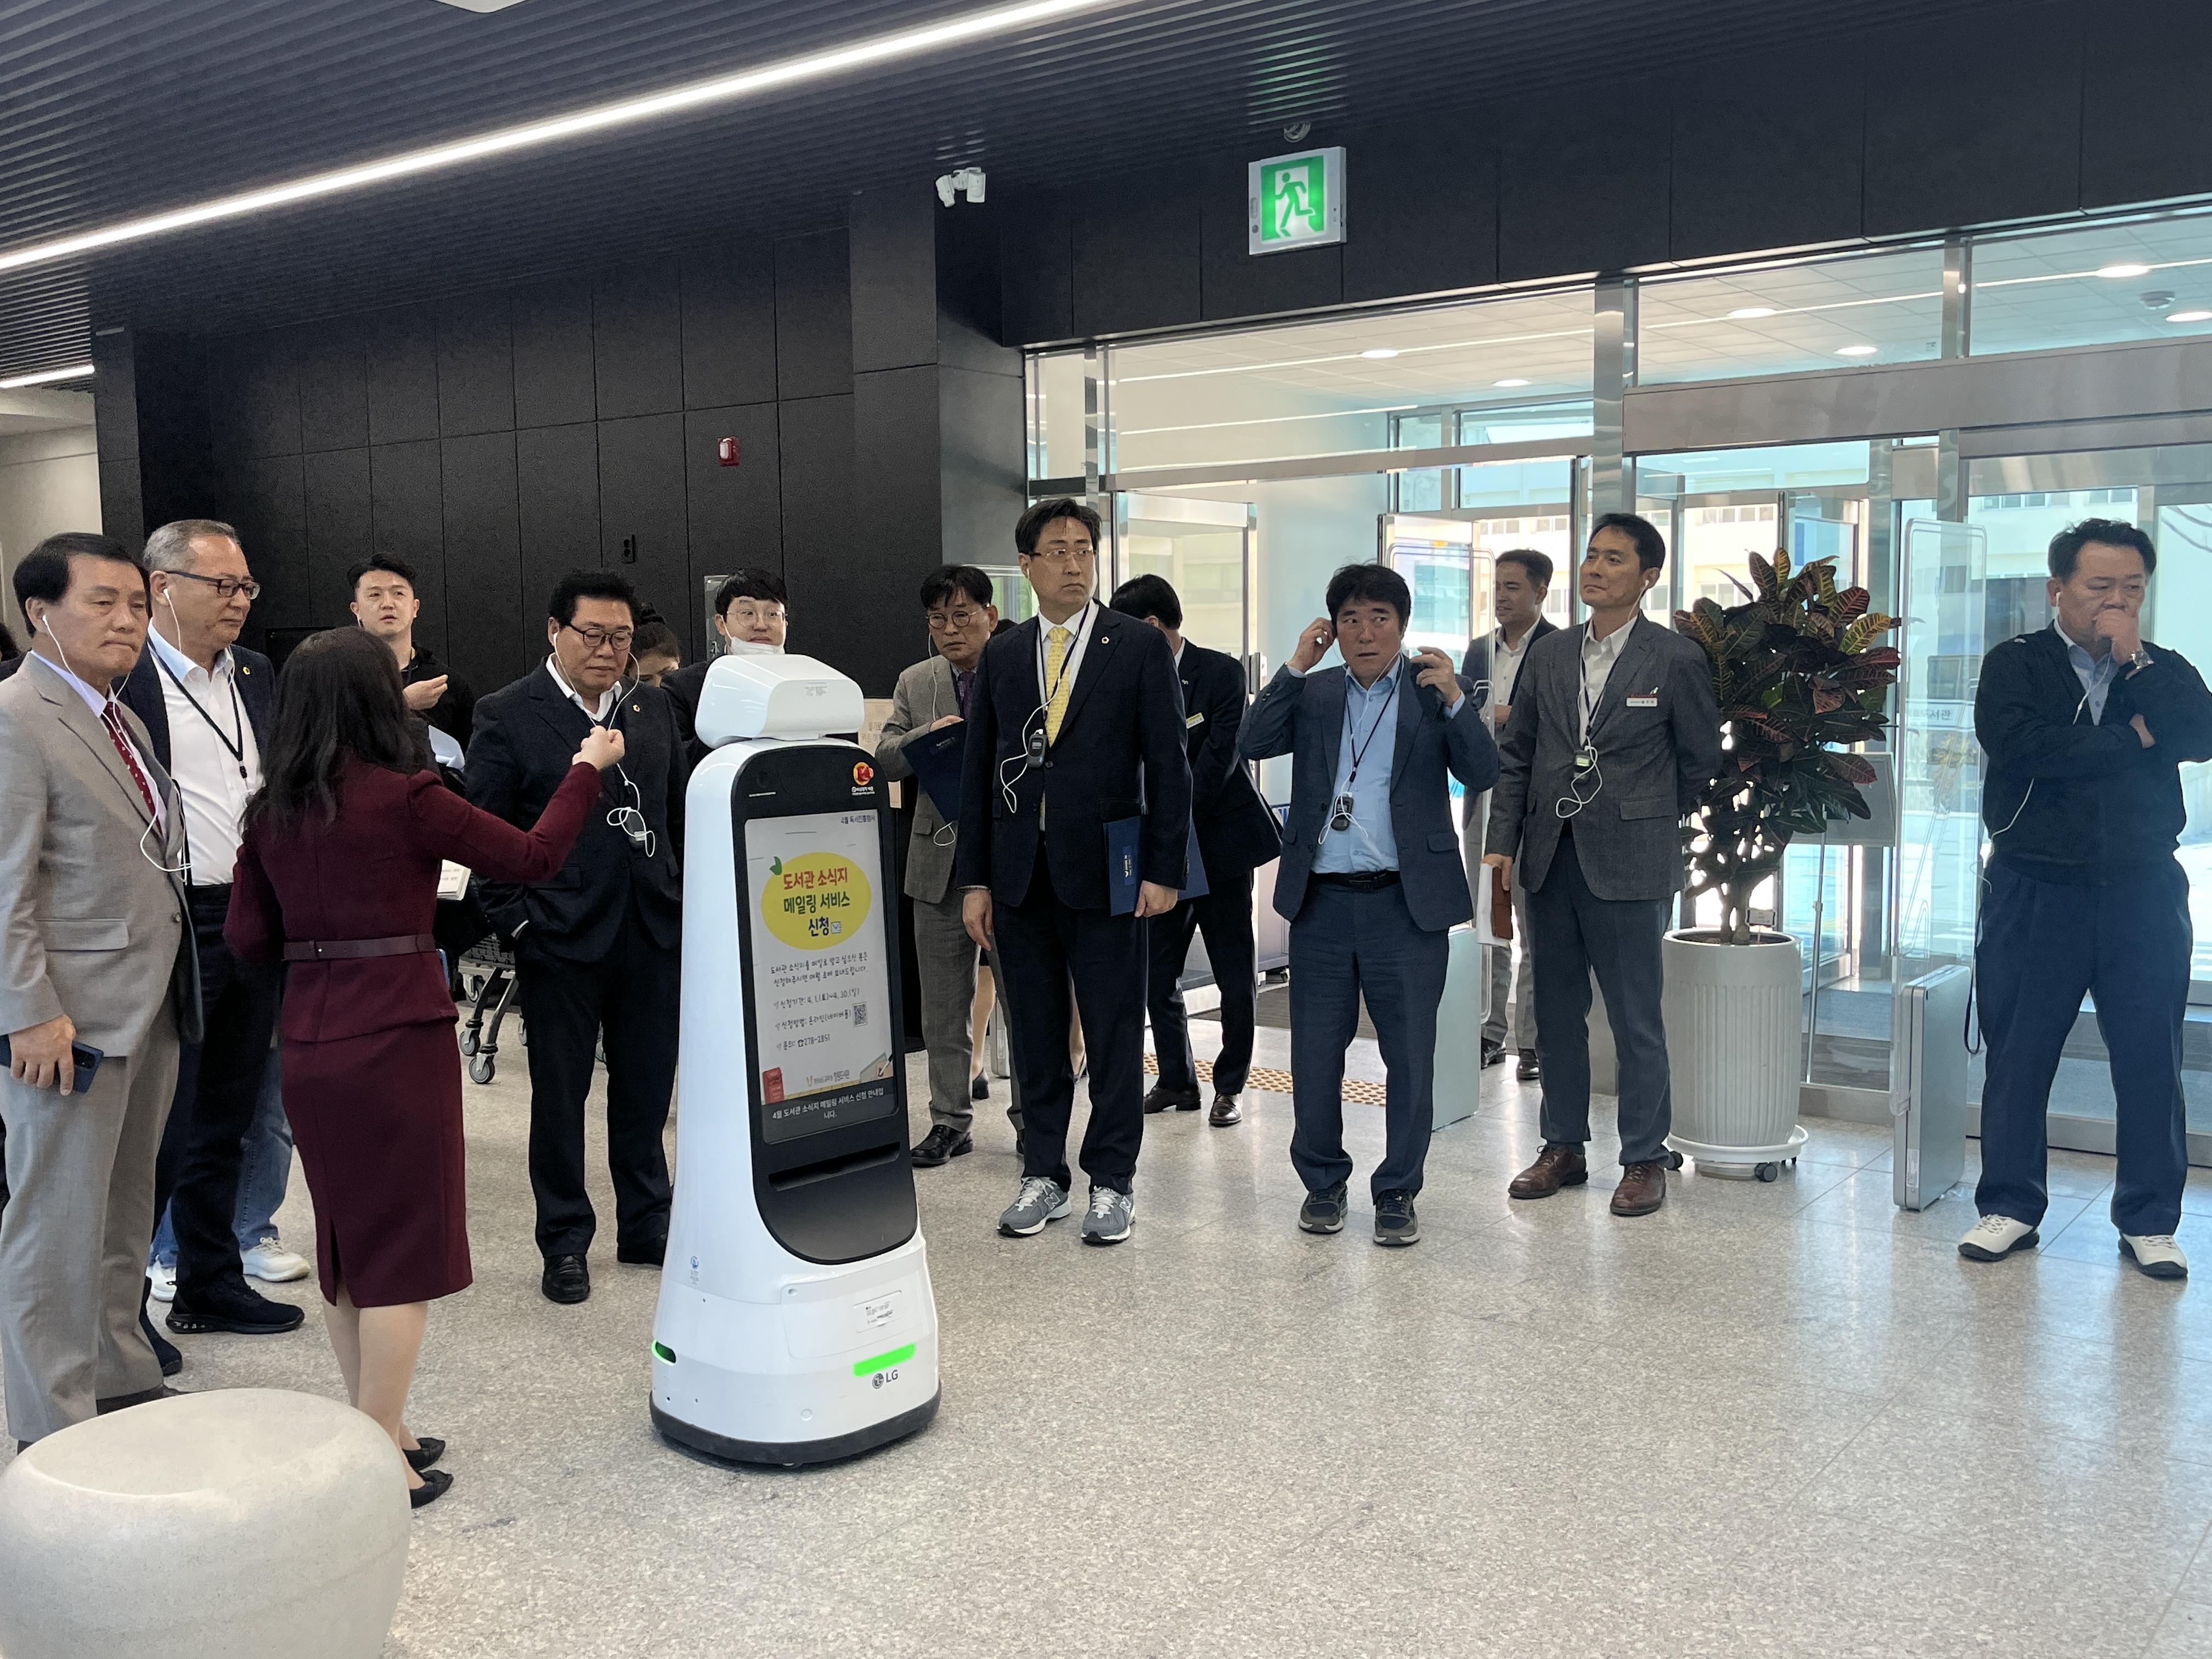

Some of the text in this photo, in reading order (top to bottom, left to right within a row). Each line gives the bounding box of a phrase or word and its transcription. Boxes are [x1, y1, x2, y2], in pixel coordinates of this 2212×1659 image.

[783, 867, 848, 890] 도서관 소식지
[783, 890, 850, 915] 메일링 서비스
[808, 916, 830, 936] 신청
[770, 964, 787, 974] 도서관
[789, 960, 809, 972] 소식지를
[811, 957, 827, 968] 메일로
[830, 956, 840, 966] 받고
[842, 954, 856, 964] 싶으신
[774, 974, 808, 987] 신청해주시면
[780, 997, 806, 1009] 신청기간:
[781, 1017, 807, 1030] 신청방법:
[772, 1087, 884, 1120] 4월 도서관 소식지 메일링 서비스 신청 안내입
[823, 1110, 837, 1120] 니다.
[885, 1369, 899, 1383] LG
